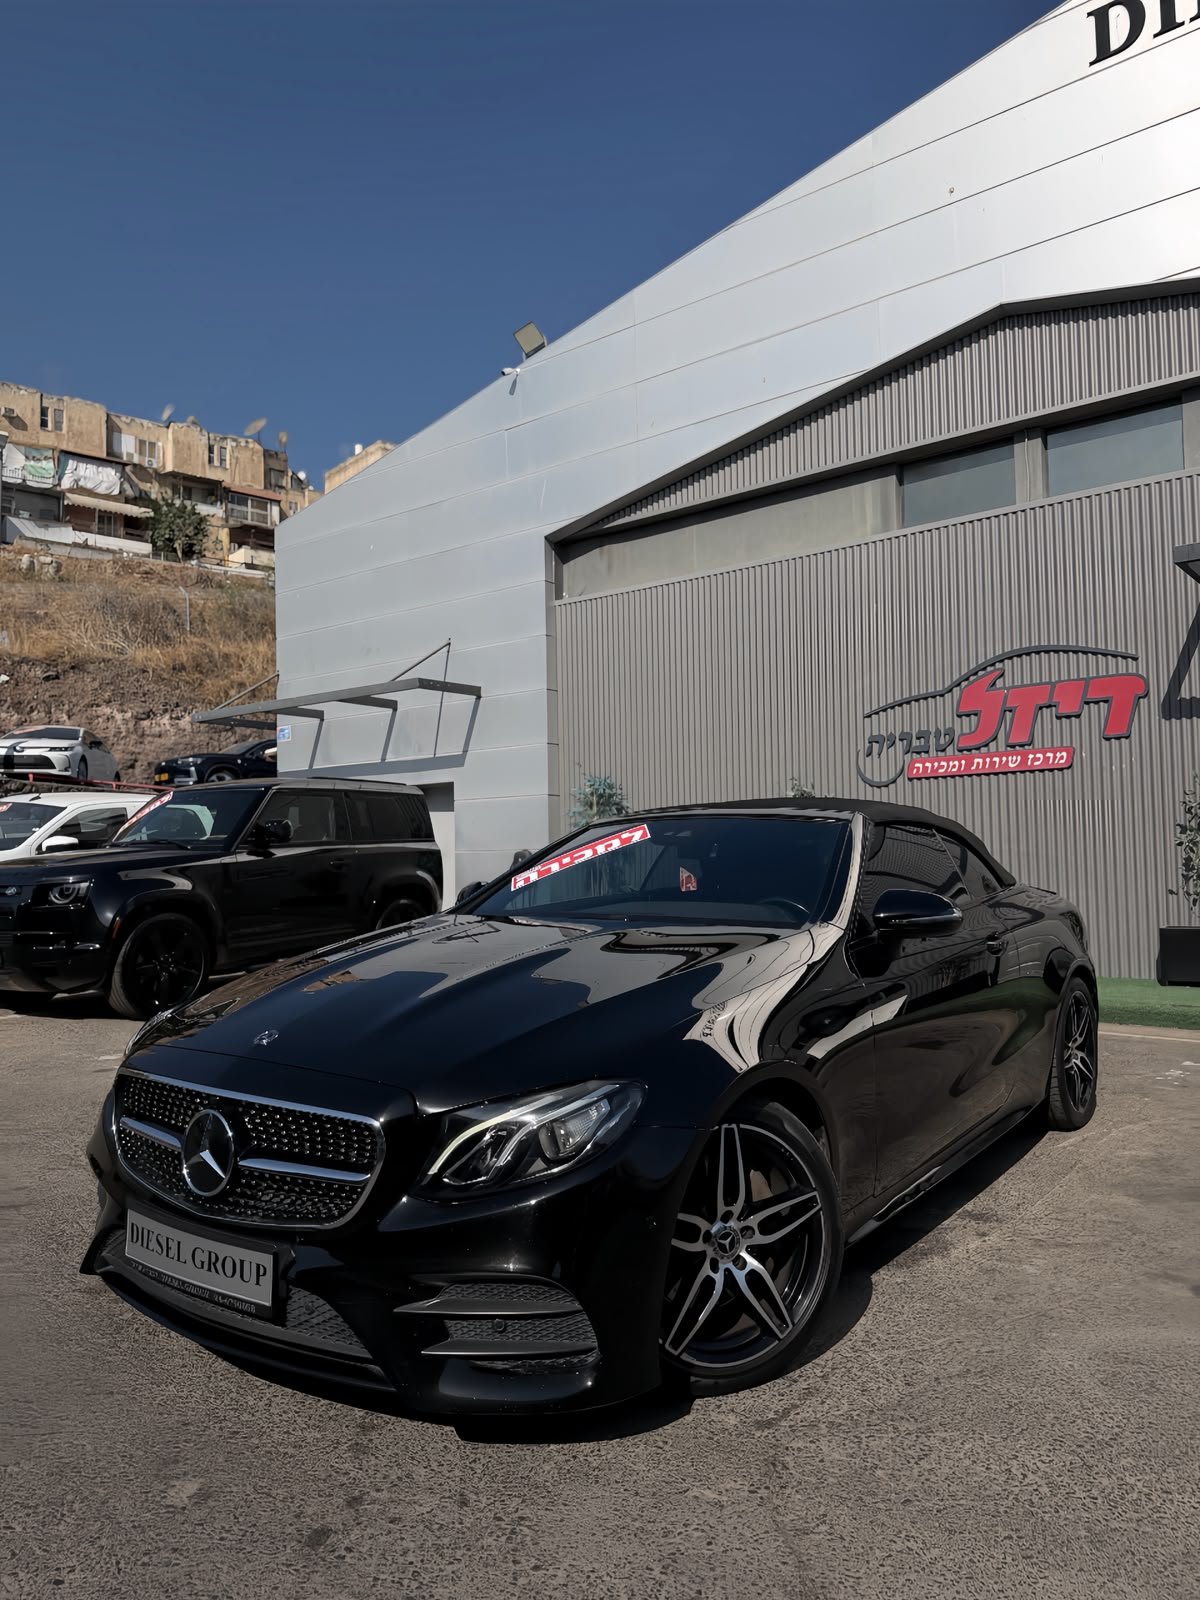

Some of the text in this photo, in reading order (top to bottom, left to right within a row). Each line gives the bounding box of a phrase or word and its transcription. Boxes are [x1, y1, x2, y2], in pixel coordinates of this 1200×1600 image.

[1086, 0, 1200, 67] DI
[866, 668, 1149, 758] דיזל טבריה
[911, 749, 1068, 776] מרכז שירות ומכירה
[515, 829, 644, 889] למכירה
[130, 1222, 187, 1264] DIESEL
[191, 1247, 267, 1287] GROUP
